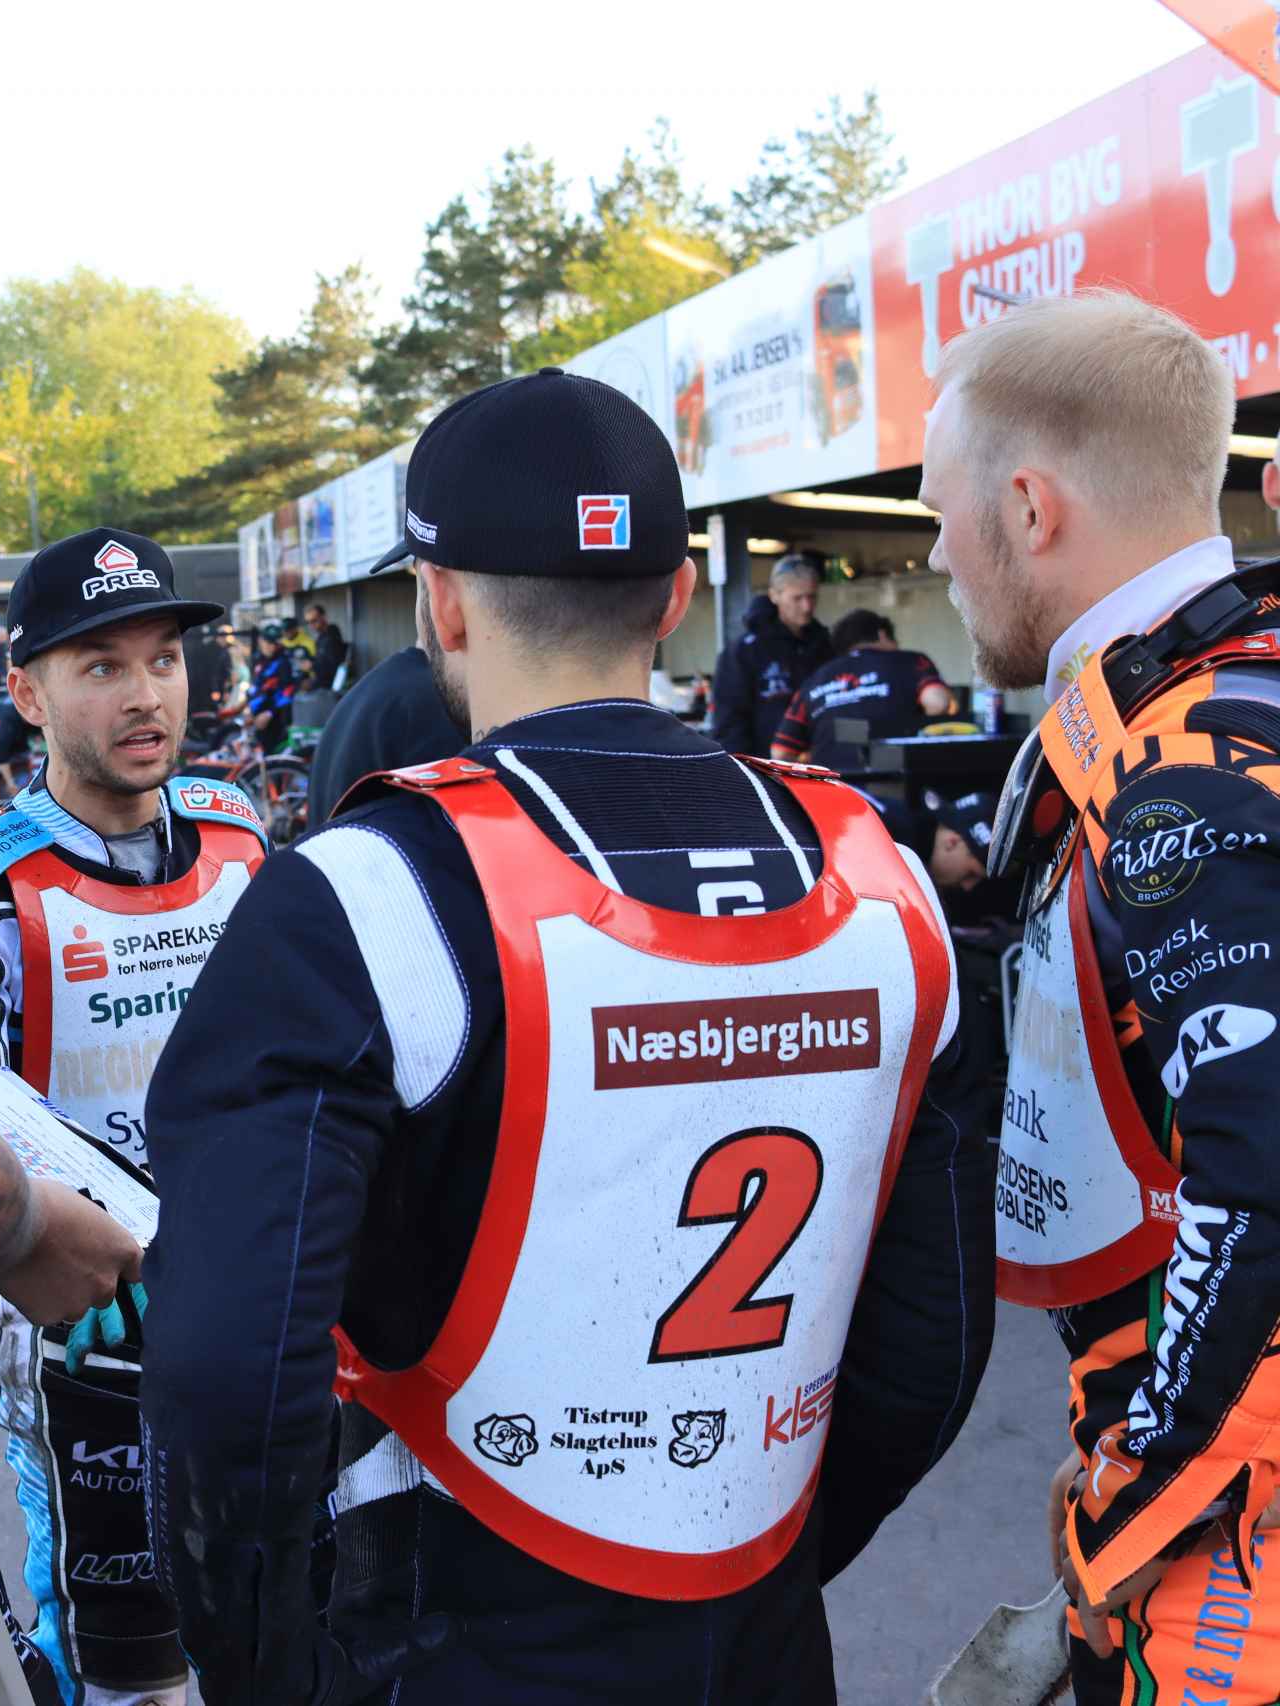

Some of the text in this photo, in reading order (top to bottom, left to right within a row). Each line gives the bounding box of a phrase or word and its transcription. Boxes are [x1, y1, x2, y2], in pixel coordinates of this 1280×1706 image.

[958, 134, 1121, 262] THOR BYG
[959, 230, 1087, 330] OUTRUP
[82, 569, 161, 600] PRES
[1126, 802, 1185, 826] SØRENSENS
[1137, 885, 1177, 902] BRØNS
[117, 950, 208, 976] for Nørre Nebel
[1124, 917, 1211, 979] Dansk
[1150, 942, 1271, 1004] Revision
[606, 1011, 870, 1068] Næsbjerghus
[1003, 1087, 1049, 1144] ank
[646, 1125, 824, 1365] 2
[1128, 1209, 1252, 1455] Sammen bygger vi professionelt
[549, 1431, 658, 1454] Slagtehus
[563, 1406, 648, 1428] Tistrup
[579, 1457, 626, 1480] ApS
